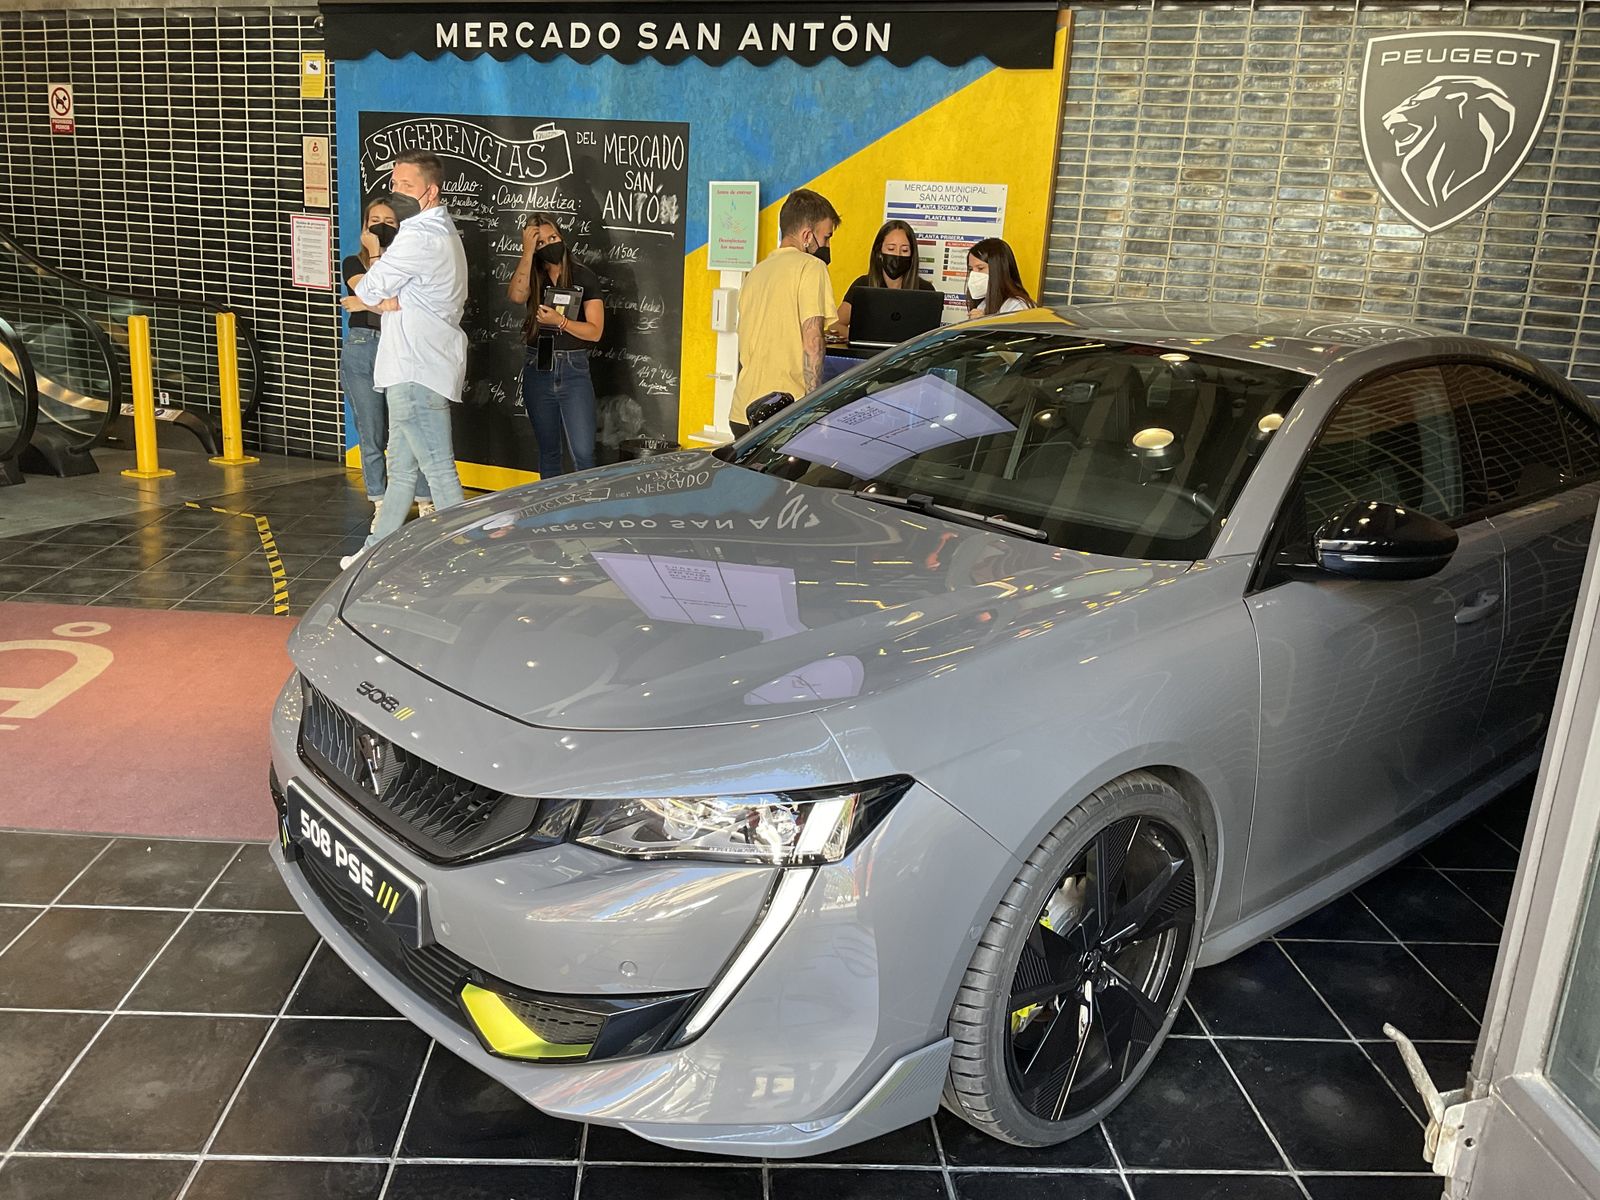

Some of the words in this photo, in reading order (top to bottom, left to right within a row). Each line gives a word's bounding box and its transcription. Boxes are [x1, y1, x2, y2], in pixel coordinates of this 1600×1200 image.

[436, 22, 621, 50] MERCADO
[637, 22, 721, 51] SAN
[1380, 48, 1541, 68] PEUGEOT
[576, 131, 597, 145] DEL
[603, 132, 685, 171] MERCADO
[624, 170, 654, 193] SAN
[904, 183, 944, 193] MERCADO
[945, 185, 988, 195] MUNICIPAL
[497, 185, 525, 208] Casa
[919, 193, 937, 202] SAN
[356, 680, 400, 713] 508
[300, 808, 331, 858] 508
[334, 839, 375, 898] PSE
